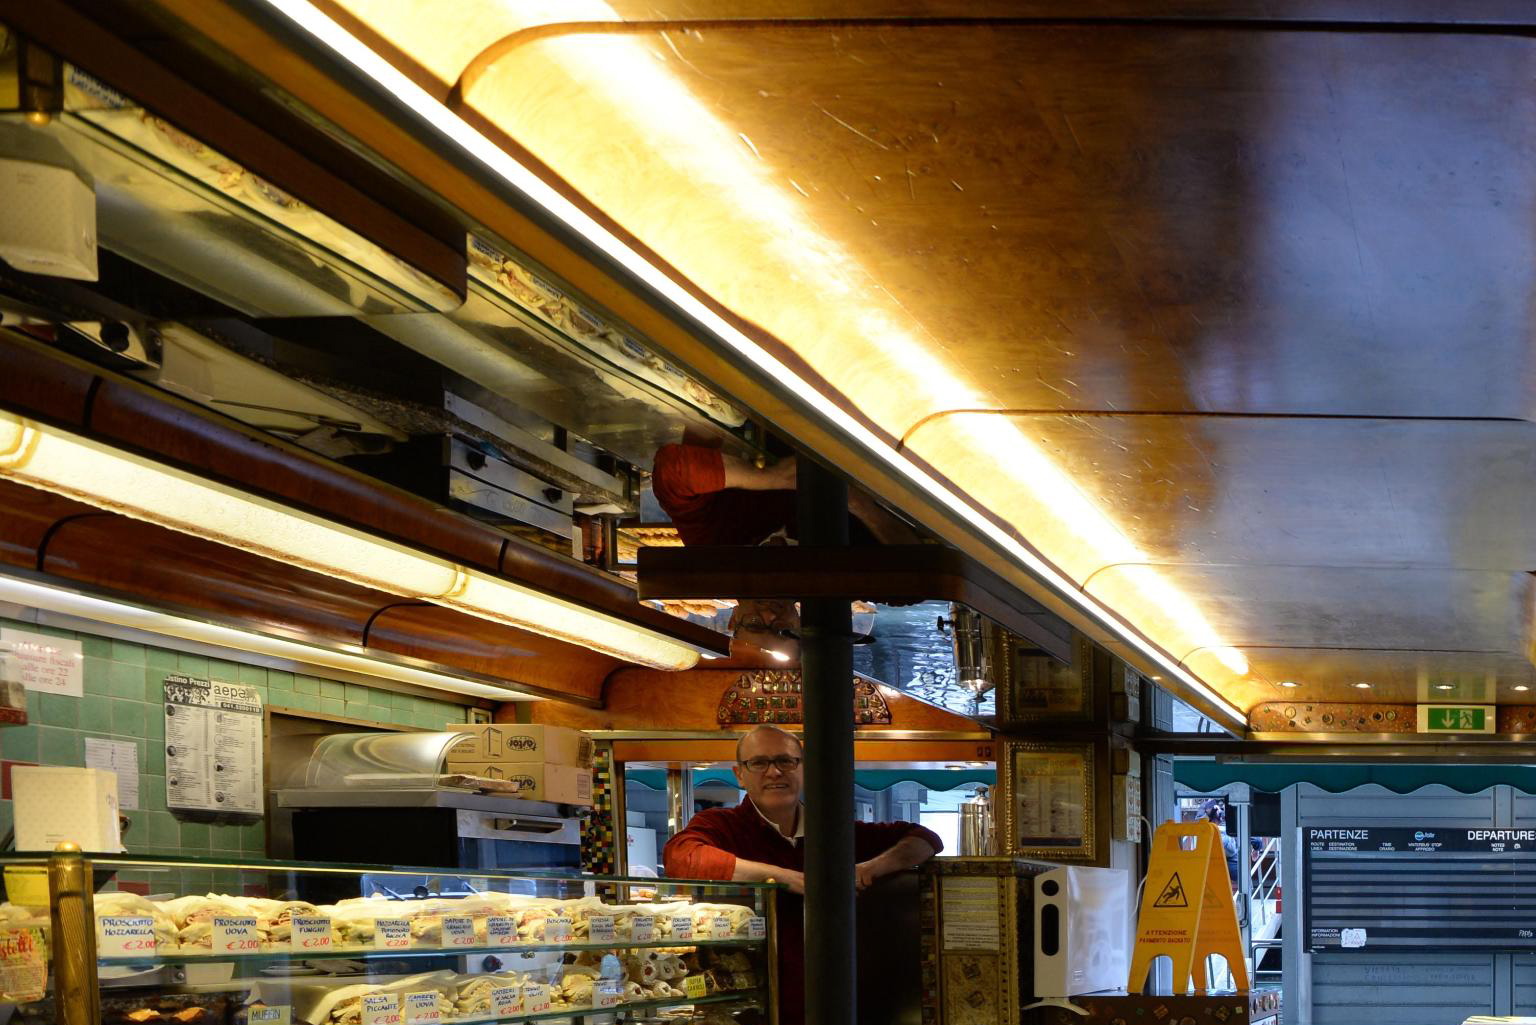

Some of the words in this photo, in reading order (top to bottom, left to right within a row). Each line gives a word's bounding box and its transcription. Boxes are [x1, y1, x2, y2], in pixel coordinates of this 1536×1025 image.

[1310, 830, 1368, 840] PARTENZE
[105, 928, 154, 936] MOZZARELLA
[364, 996, 387, 1004] SALSA
[367, 1004, 398, 1012] PICCANTE
[252, 1009, 280, 1020] MUFFIN
